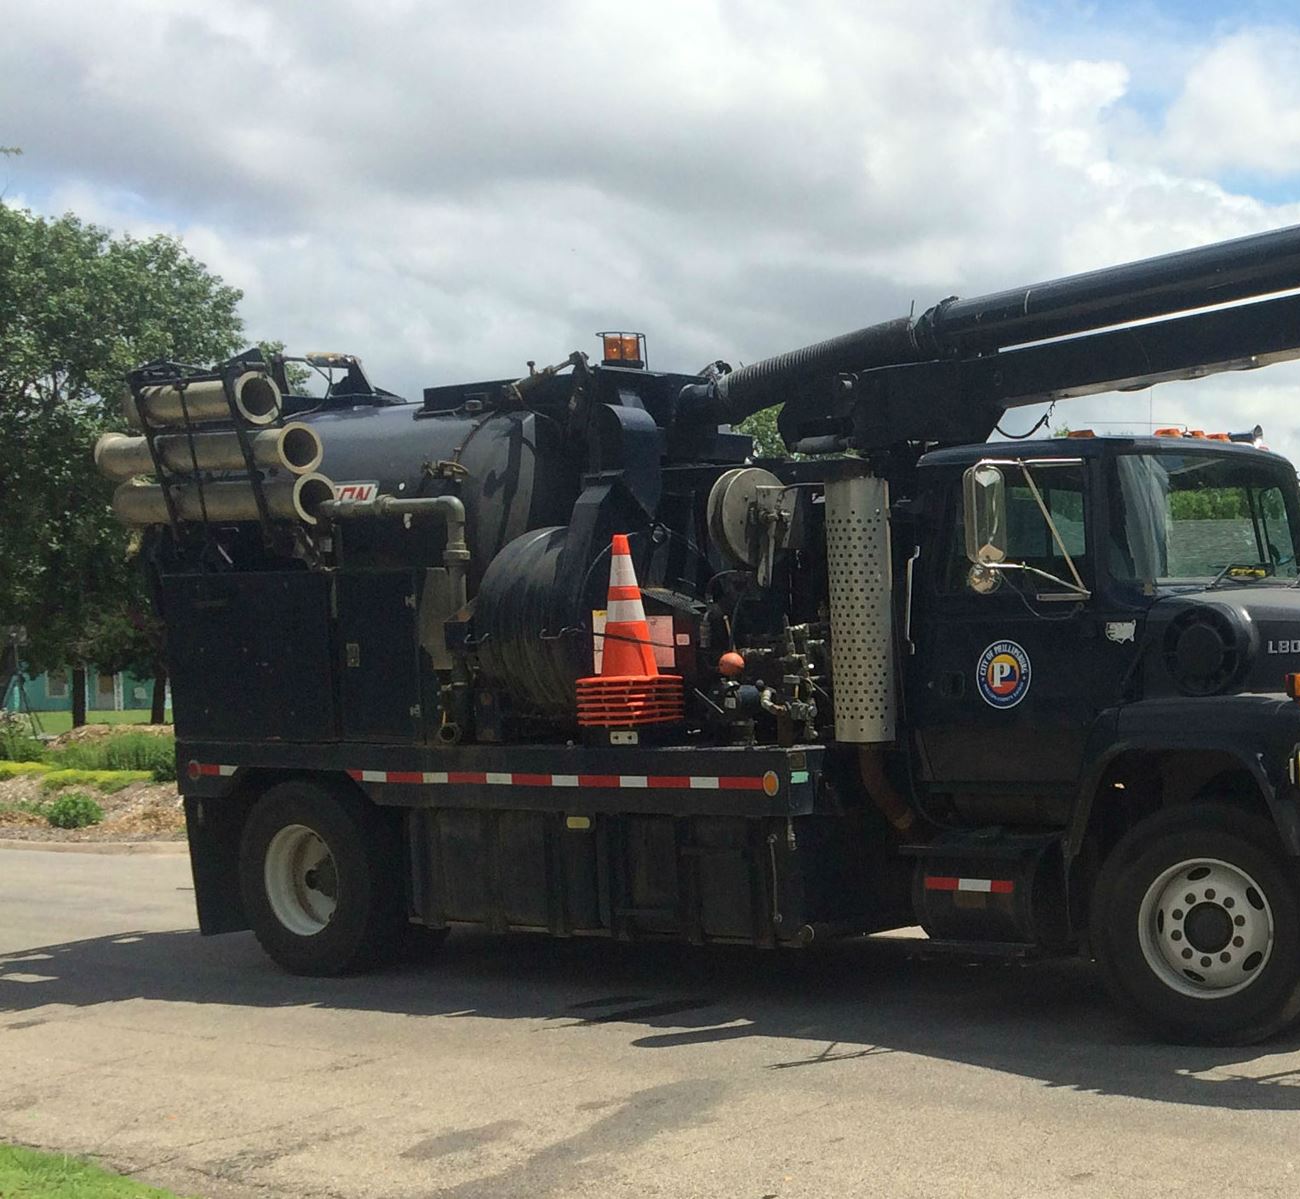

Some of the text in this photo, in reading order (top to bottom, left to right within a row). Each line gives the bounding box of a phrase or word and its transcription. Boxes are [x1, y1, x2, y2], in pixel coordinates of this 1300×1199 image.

[980, 659, 989, 676] CITY
[986, 650, 995, 661] OF
[991, 662, 1012, 688] P
